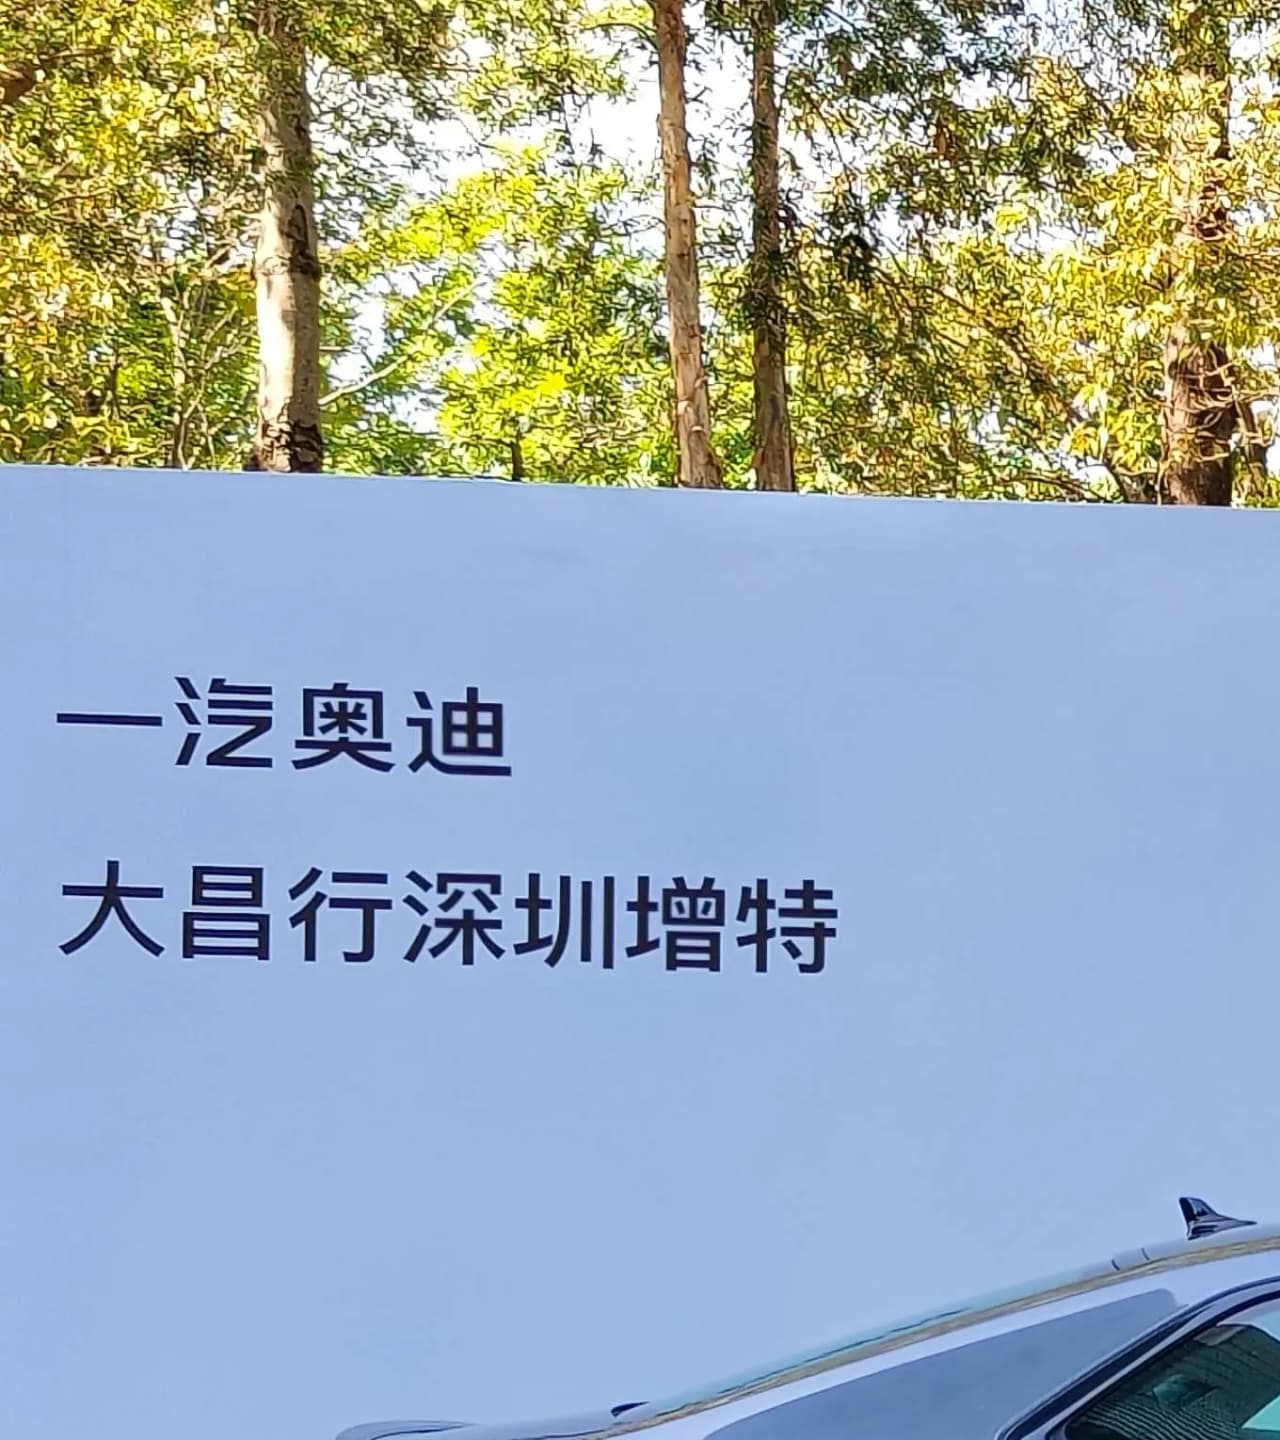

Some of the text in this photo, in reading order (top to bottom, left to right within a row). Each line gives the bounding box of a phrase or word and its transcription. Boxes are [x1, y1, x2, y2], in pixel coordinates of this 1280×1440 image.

[56, 676, 512, 777] 一汽奥迪
[58, 859, 839, 975] 大昌行深圳增特
